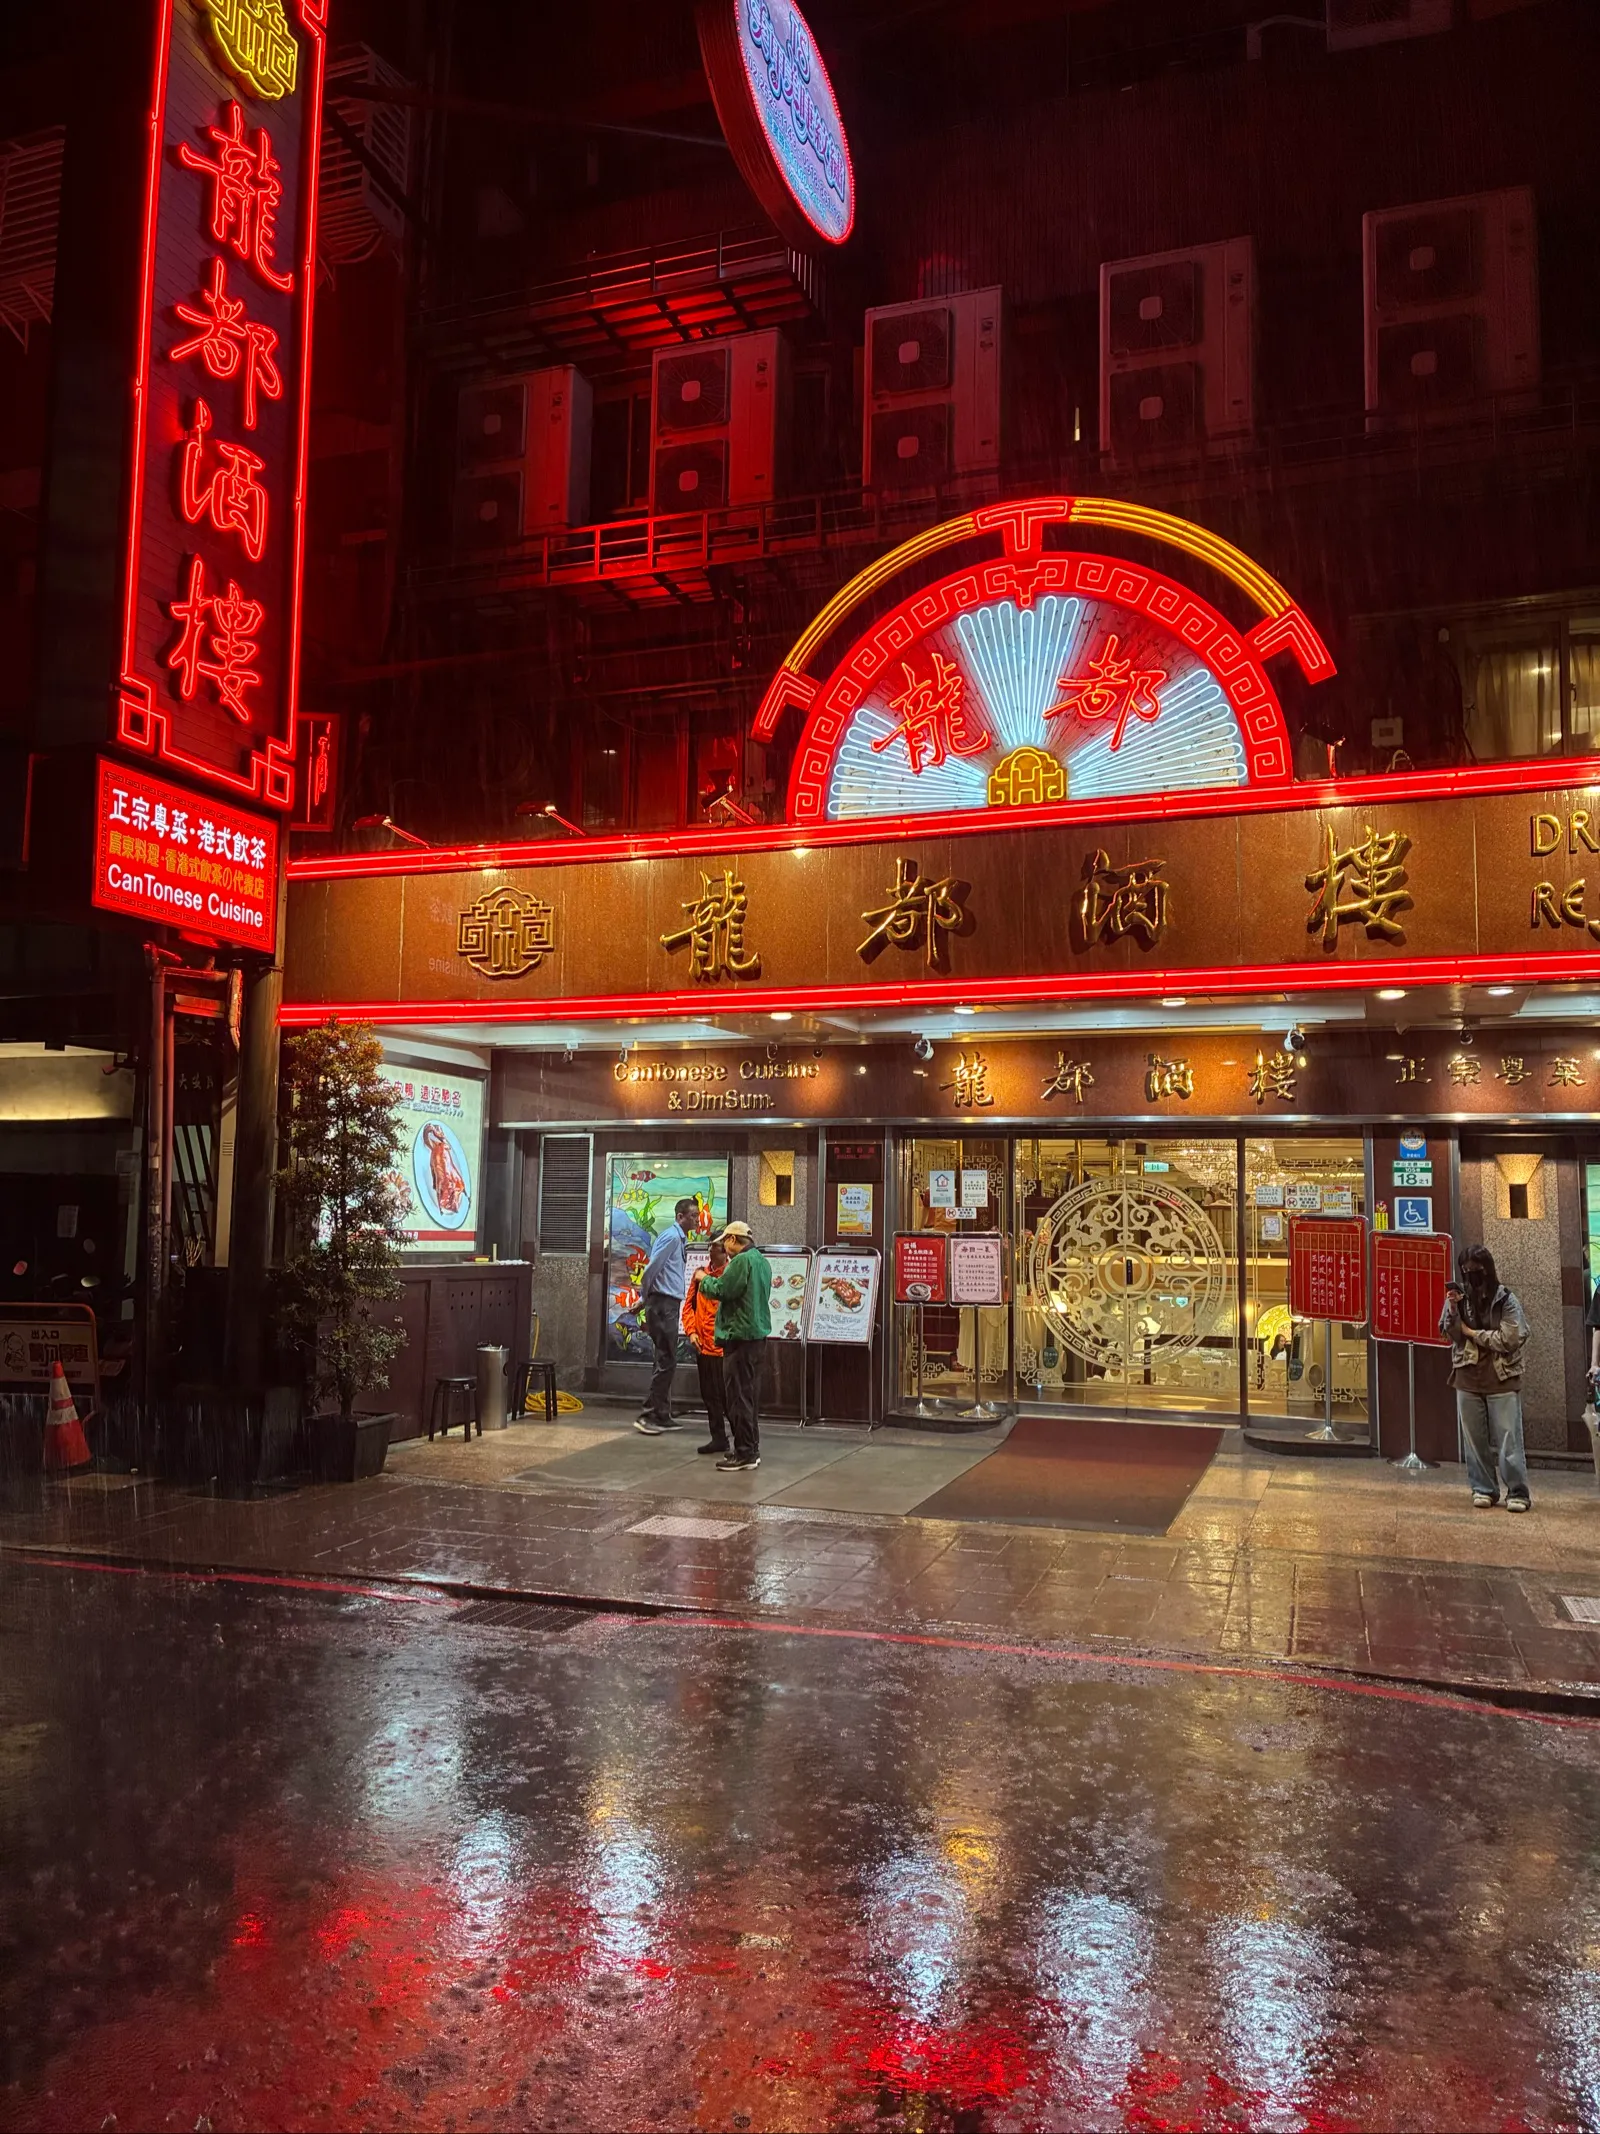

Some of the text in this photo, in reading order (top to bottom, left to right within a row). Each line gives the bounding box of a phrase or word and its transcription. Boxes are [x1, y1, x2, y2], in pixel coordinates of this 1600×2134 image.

[168, 98, 294, 724] 龍都酒樓
[870, 634, 1168, 776] 龍都
[108, 864, 263, 928] CanTonese Cuisine
[659, 824, 1410, 980] 龍都酒樓
[1531, 878, 1600, 942] RE
[420, 1085, 462, 1108] 遠近馳名
[613, 1060, 820, 1082] CanTonese Cuisine
[667, 1090, 683, 1111] &
[939, 1048, 1298, 1107] 龍都酒樓
[31, 1329, 59, 1340] 出入口
